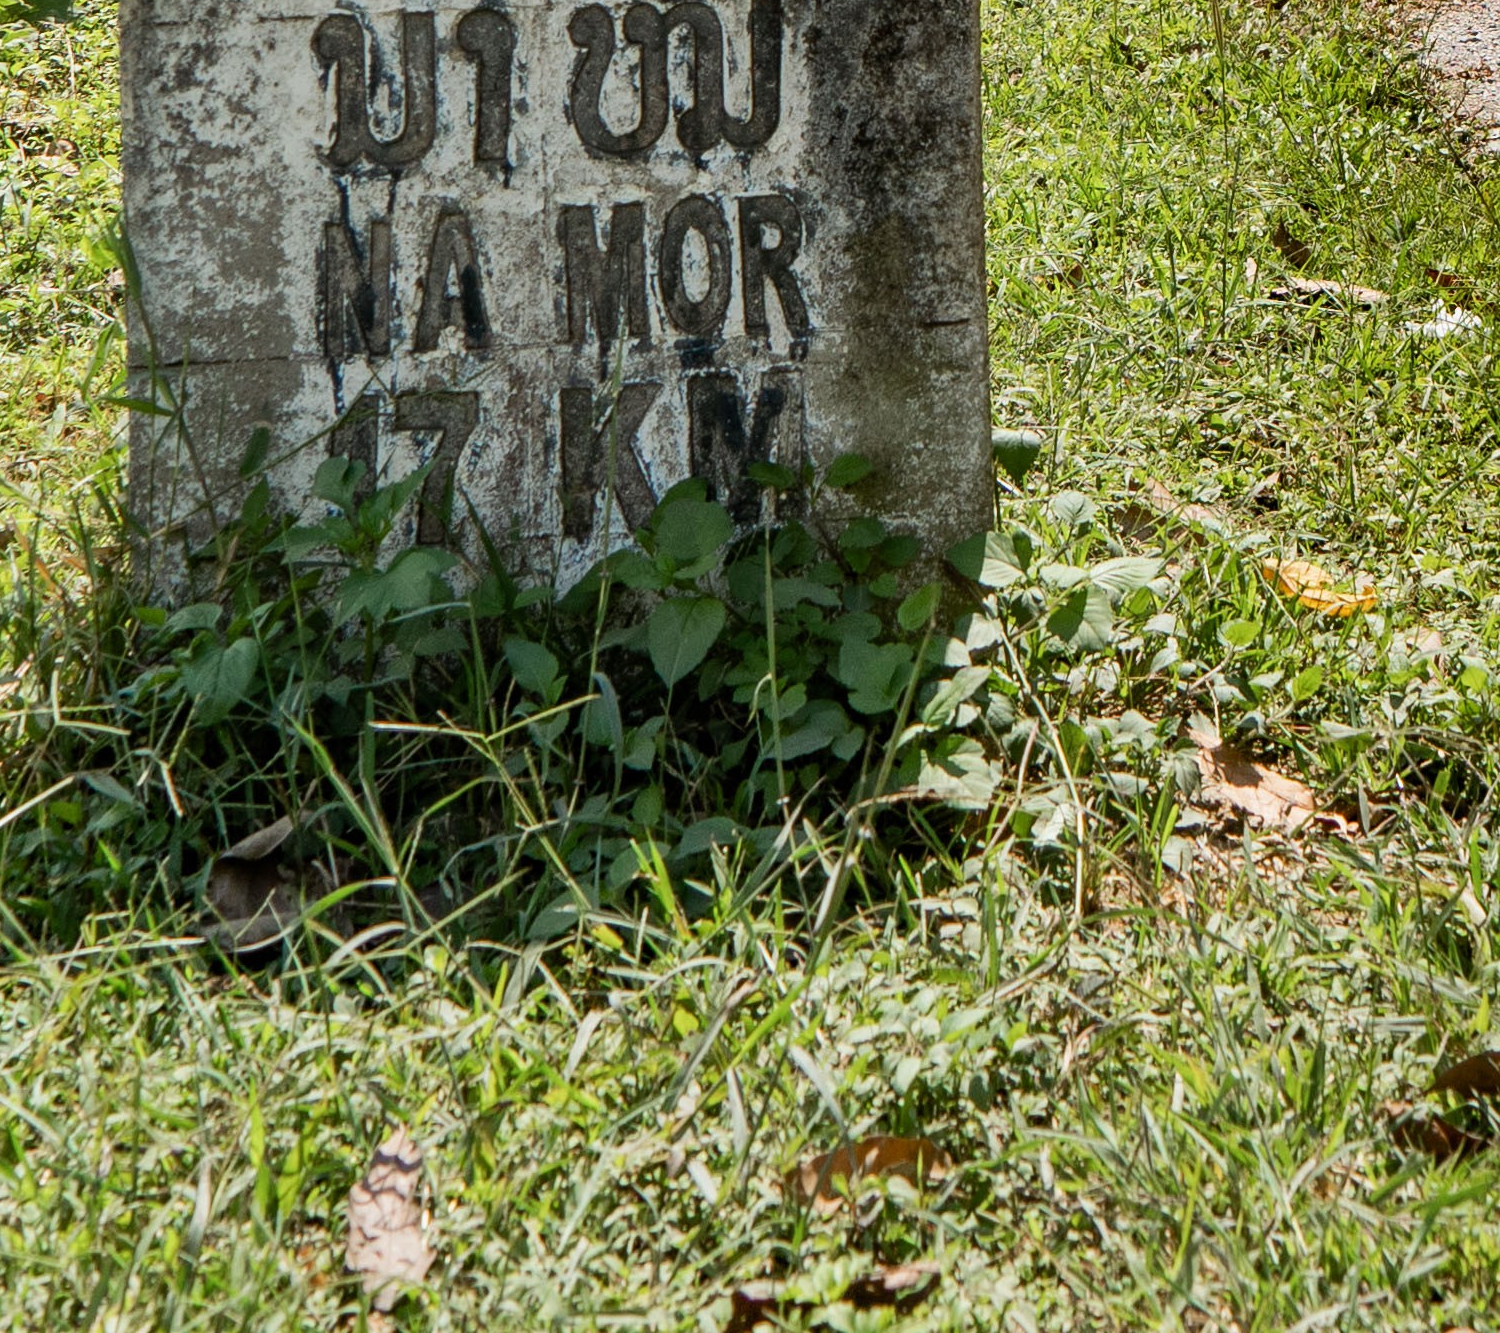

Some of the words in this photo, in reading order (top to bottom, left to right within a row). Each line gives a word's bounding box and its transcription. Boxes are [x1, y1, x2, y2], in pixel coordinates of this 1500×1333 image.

[322, 203, 491, 357] NA
[557, 195, 810, 343] MOR
[558, 369, 806, 539] KM
